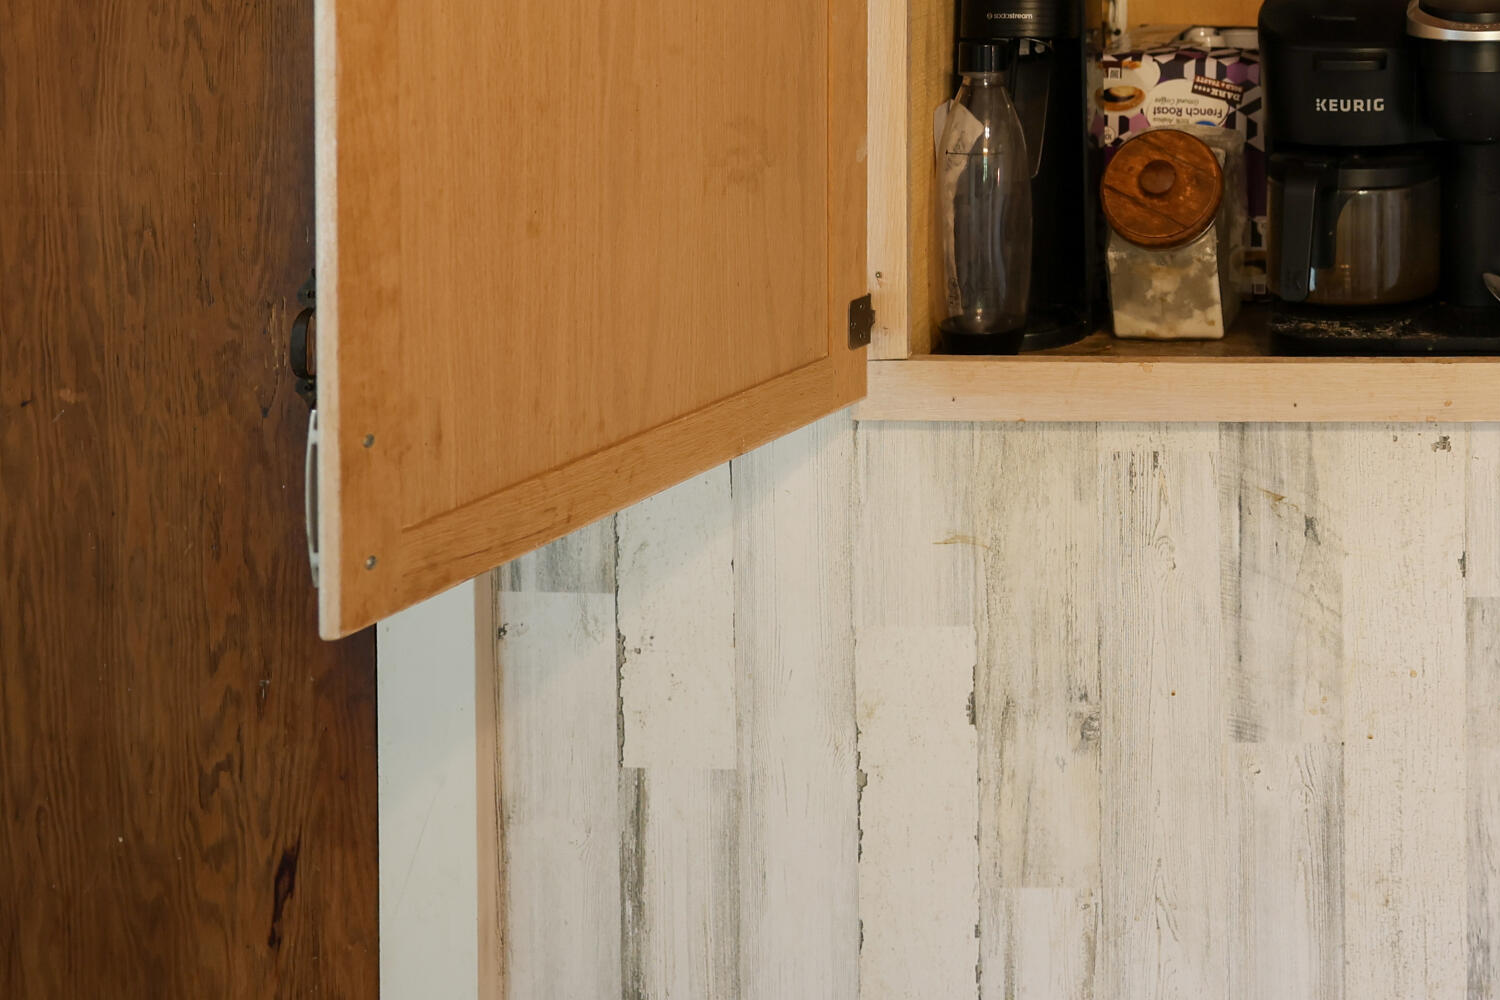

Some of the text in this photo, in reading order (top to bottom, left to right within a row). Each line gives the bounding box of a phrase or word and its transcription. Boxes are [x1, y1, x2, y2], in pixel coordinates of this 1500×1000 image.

[993, 12, 1033, 20] sodastream
[1315, 97, 1384, 112] KEURIG
[1153, 105, 1223, 118] French Roast
